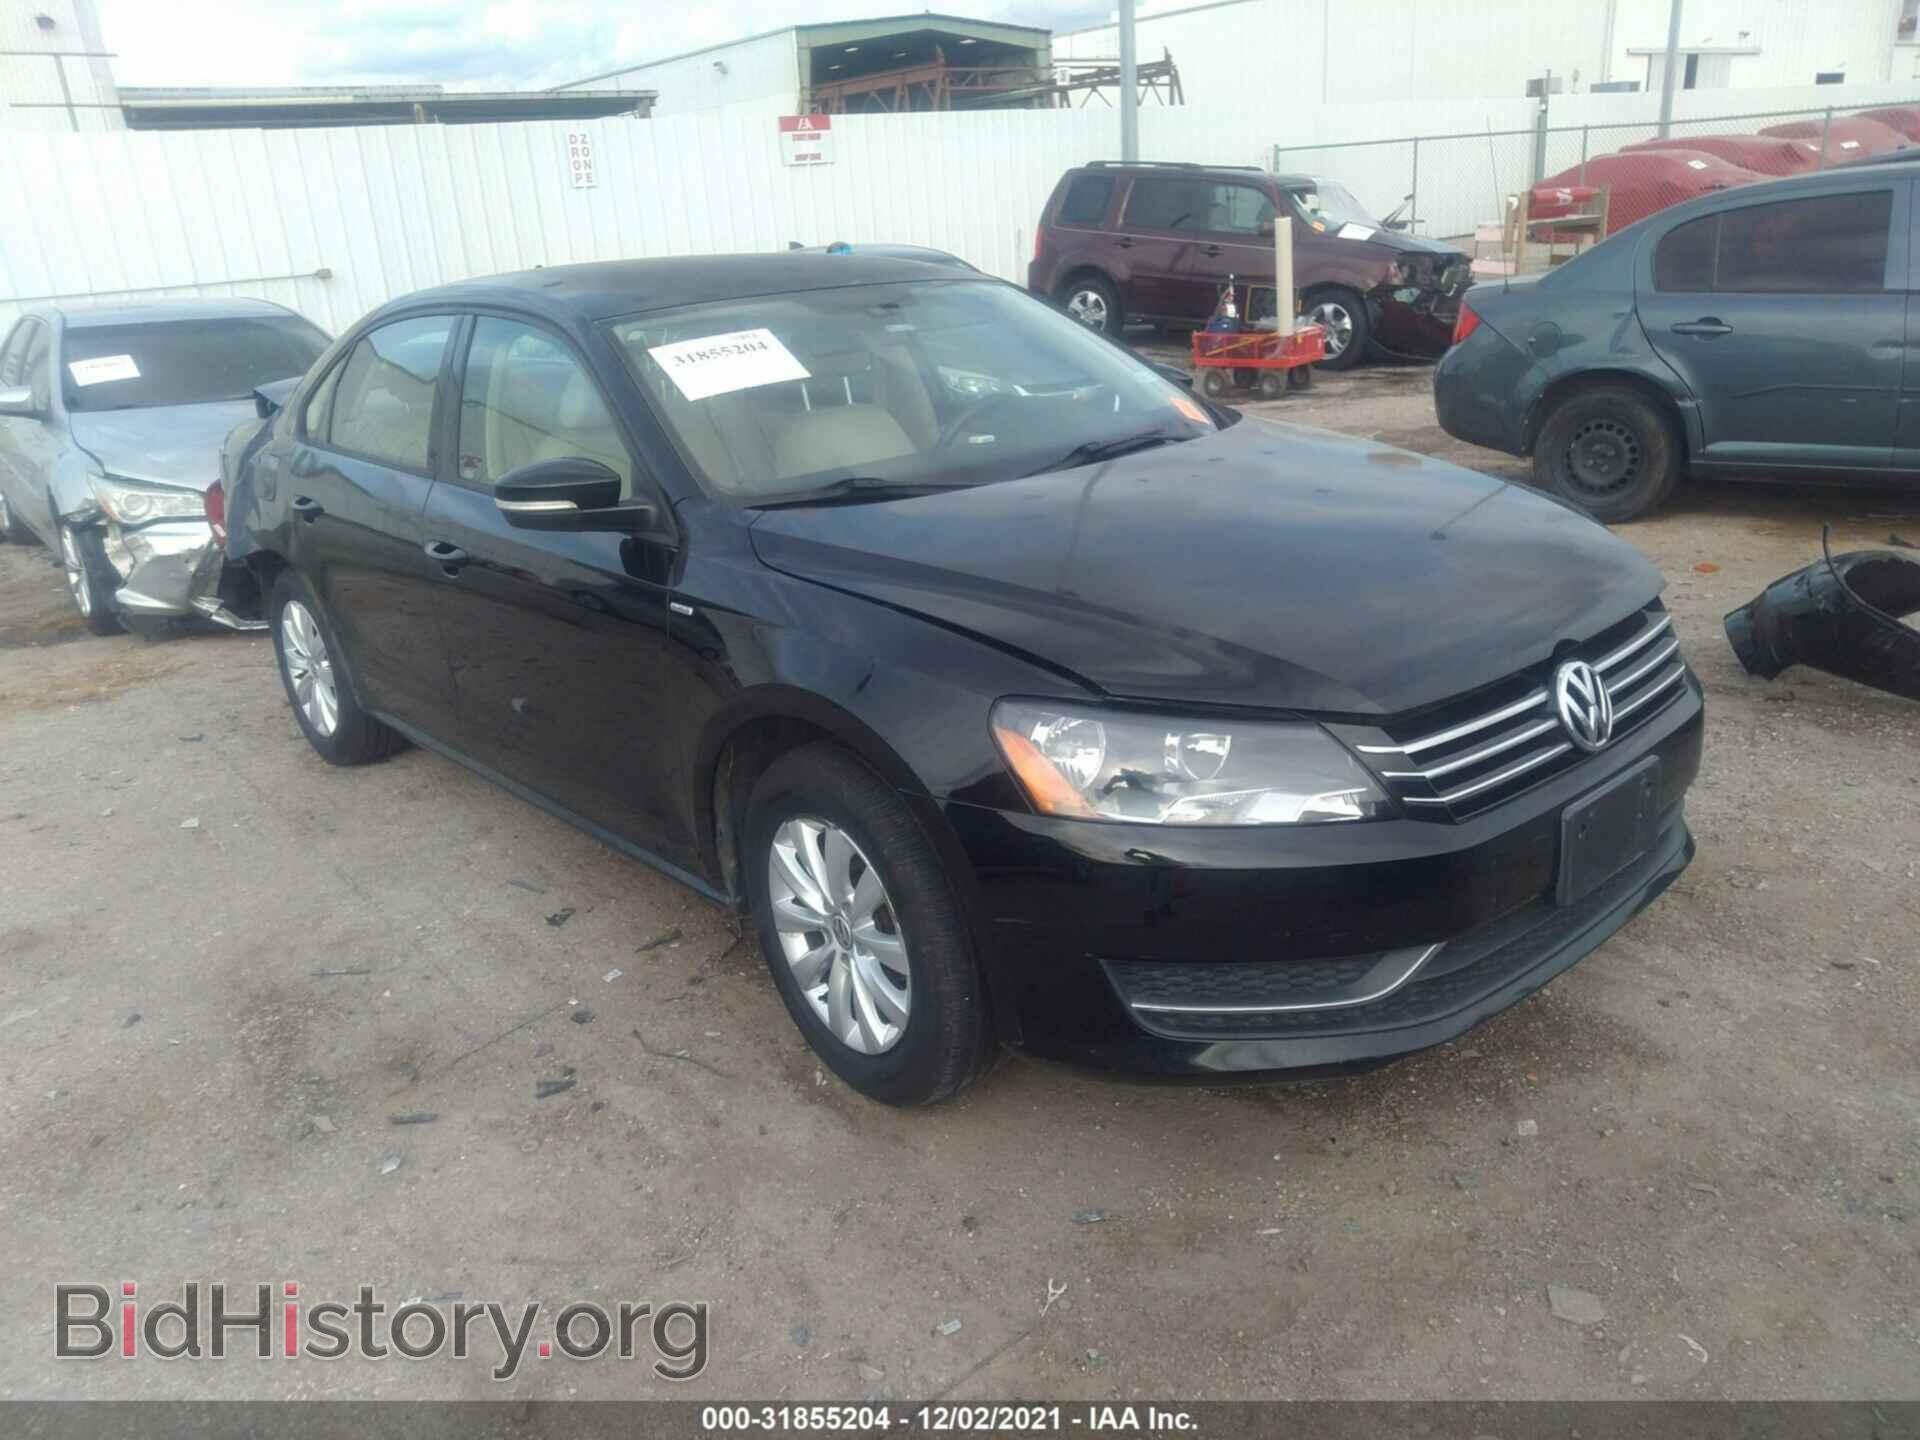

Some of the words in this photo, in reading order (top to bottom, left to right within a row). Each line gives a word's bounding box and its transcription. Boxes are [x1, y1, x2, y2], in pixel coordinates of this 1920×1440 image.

[568, 133, 583, 184] DROP
[579, 133, 593, 183] ZONE
[673, 340, 769, 367] 31855204
